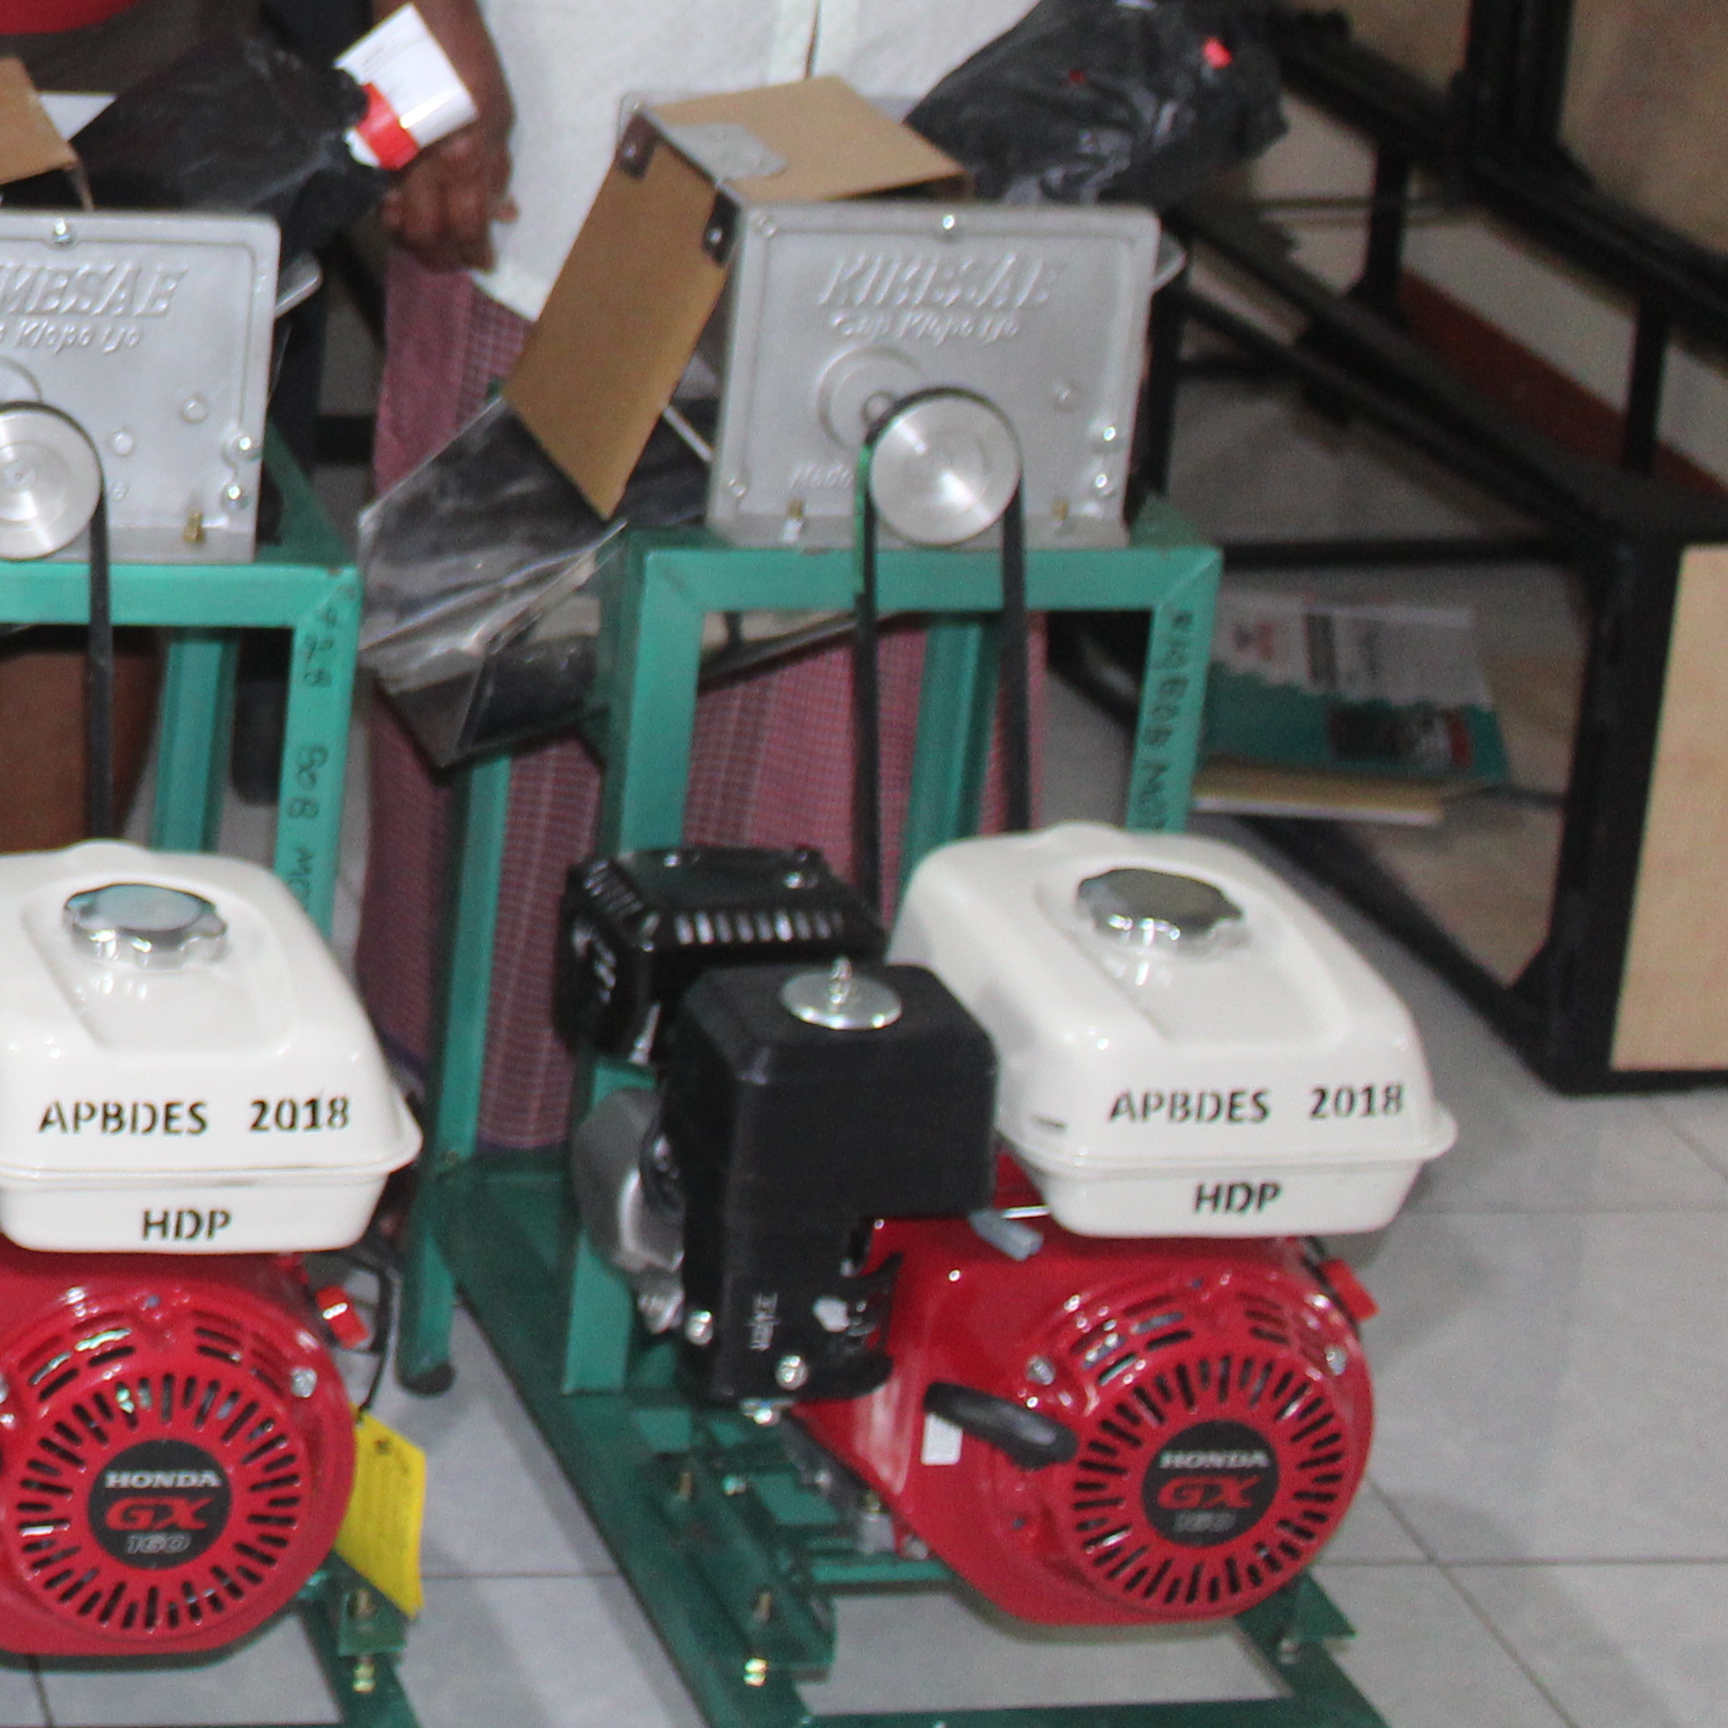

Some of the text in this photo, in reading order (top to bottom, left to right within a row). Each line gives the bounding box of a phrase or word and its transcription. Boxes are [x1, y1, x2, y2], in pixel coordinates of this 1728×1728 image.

[39, 1097, 350, 1135] APBDES 2018
[1109, 1084, 1404, 1124] APBDES 2018
[1194, 1182, 1282, 1213] HDP
[141, 1209, 231, 1240] HDP
[104, 1469, 223, 1489] HONDA
[1157, 1476, 1260, 1510] GX
[106, 1497, 213, 1531] GX
